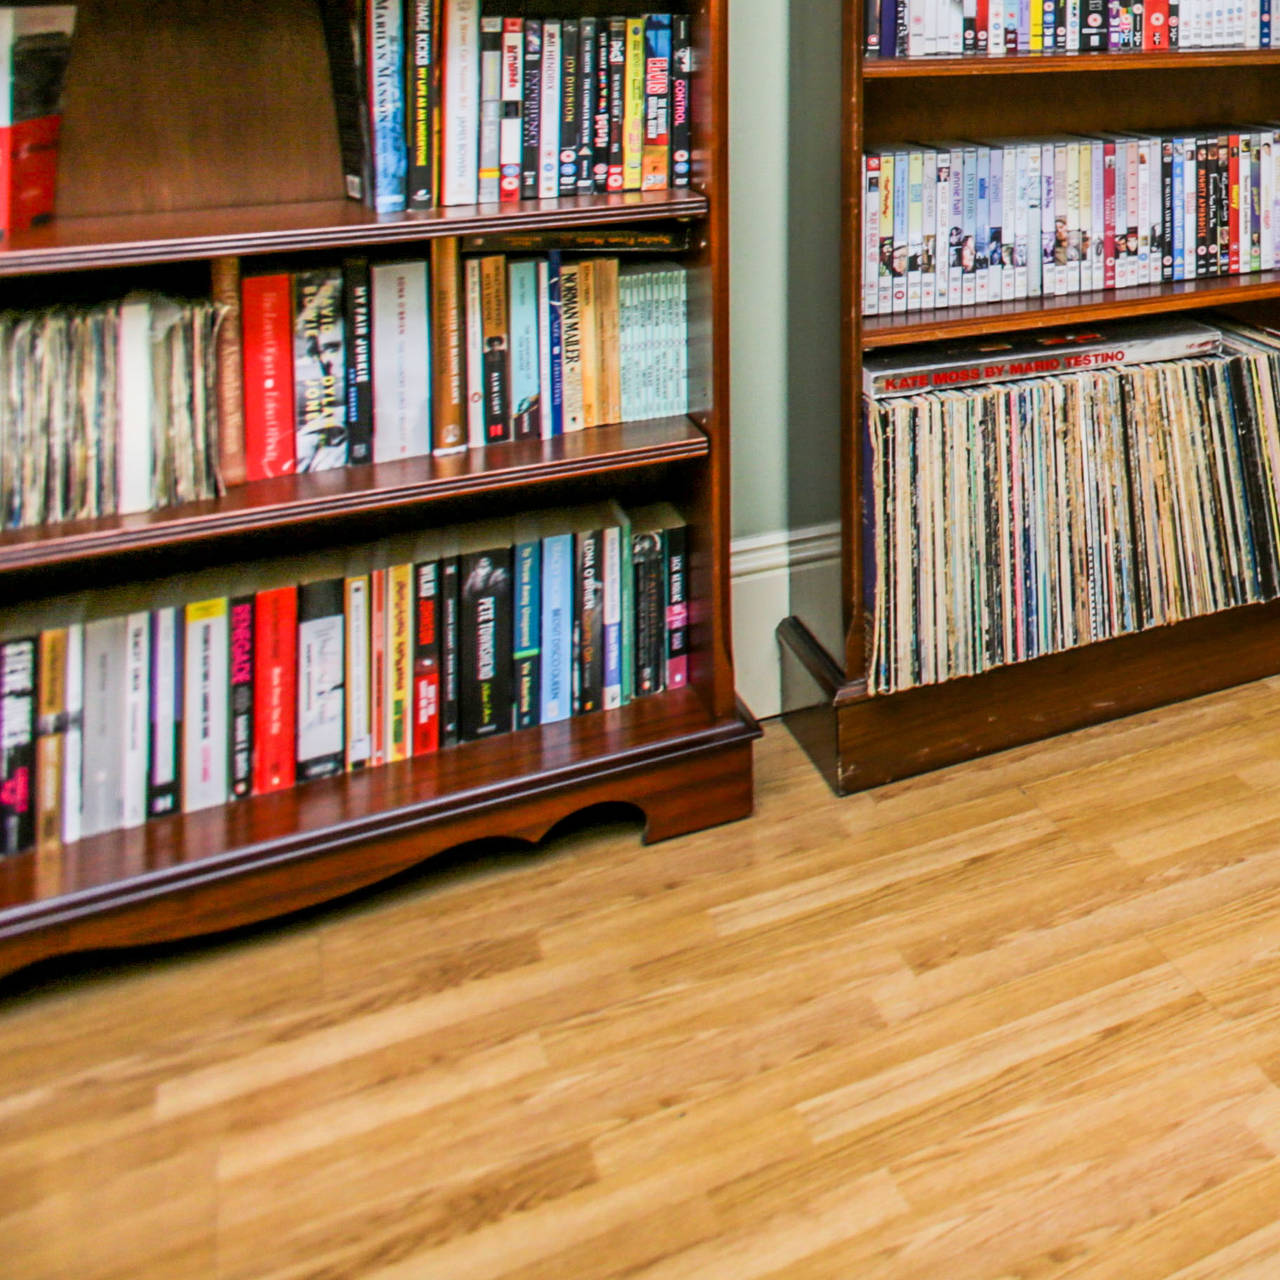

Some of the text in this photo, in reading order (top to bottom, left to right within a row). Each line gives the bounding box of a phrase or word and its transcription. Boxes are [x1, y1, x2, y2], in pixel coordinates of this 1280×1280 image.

[415, 32, 430, 65] KICKS
[376, 65, 391, 123] MANSON
[563, 55, 577, 122] JOY DIVISION
[646, 57, 669, 95] ELVIS
[674, 79, 686, 127] CONTROL
[952, 171, 962, 216] annie hall
[966, 173, 975, 220] INTERIORS
[1197, 169, 1206, 196] MIGHTY
[302, 285, 321, 338] BOWIE
[562, 272, 580, 365] NORMAN MAILER
[354, 286, 369, 383] MY FAIR JUNKIE
[884, 351, 1125, 391] KATE MOSS BY MARIO TESTINO
[582, 538, 597, 569] EDNA
[477, 596, 496, 621] PETE
[582, 569, 597, 610] O'BRIEN
[231, 603, 251, 685] RENEGADE
[477, 621, 496, 680] TOWNSHEND
[551, 640, 562, 667] DISCO
[551, 668, 562, 700] QUEEN
